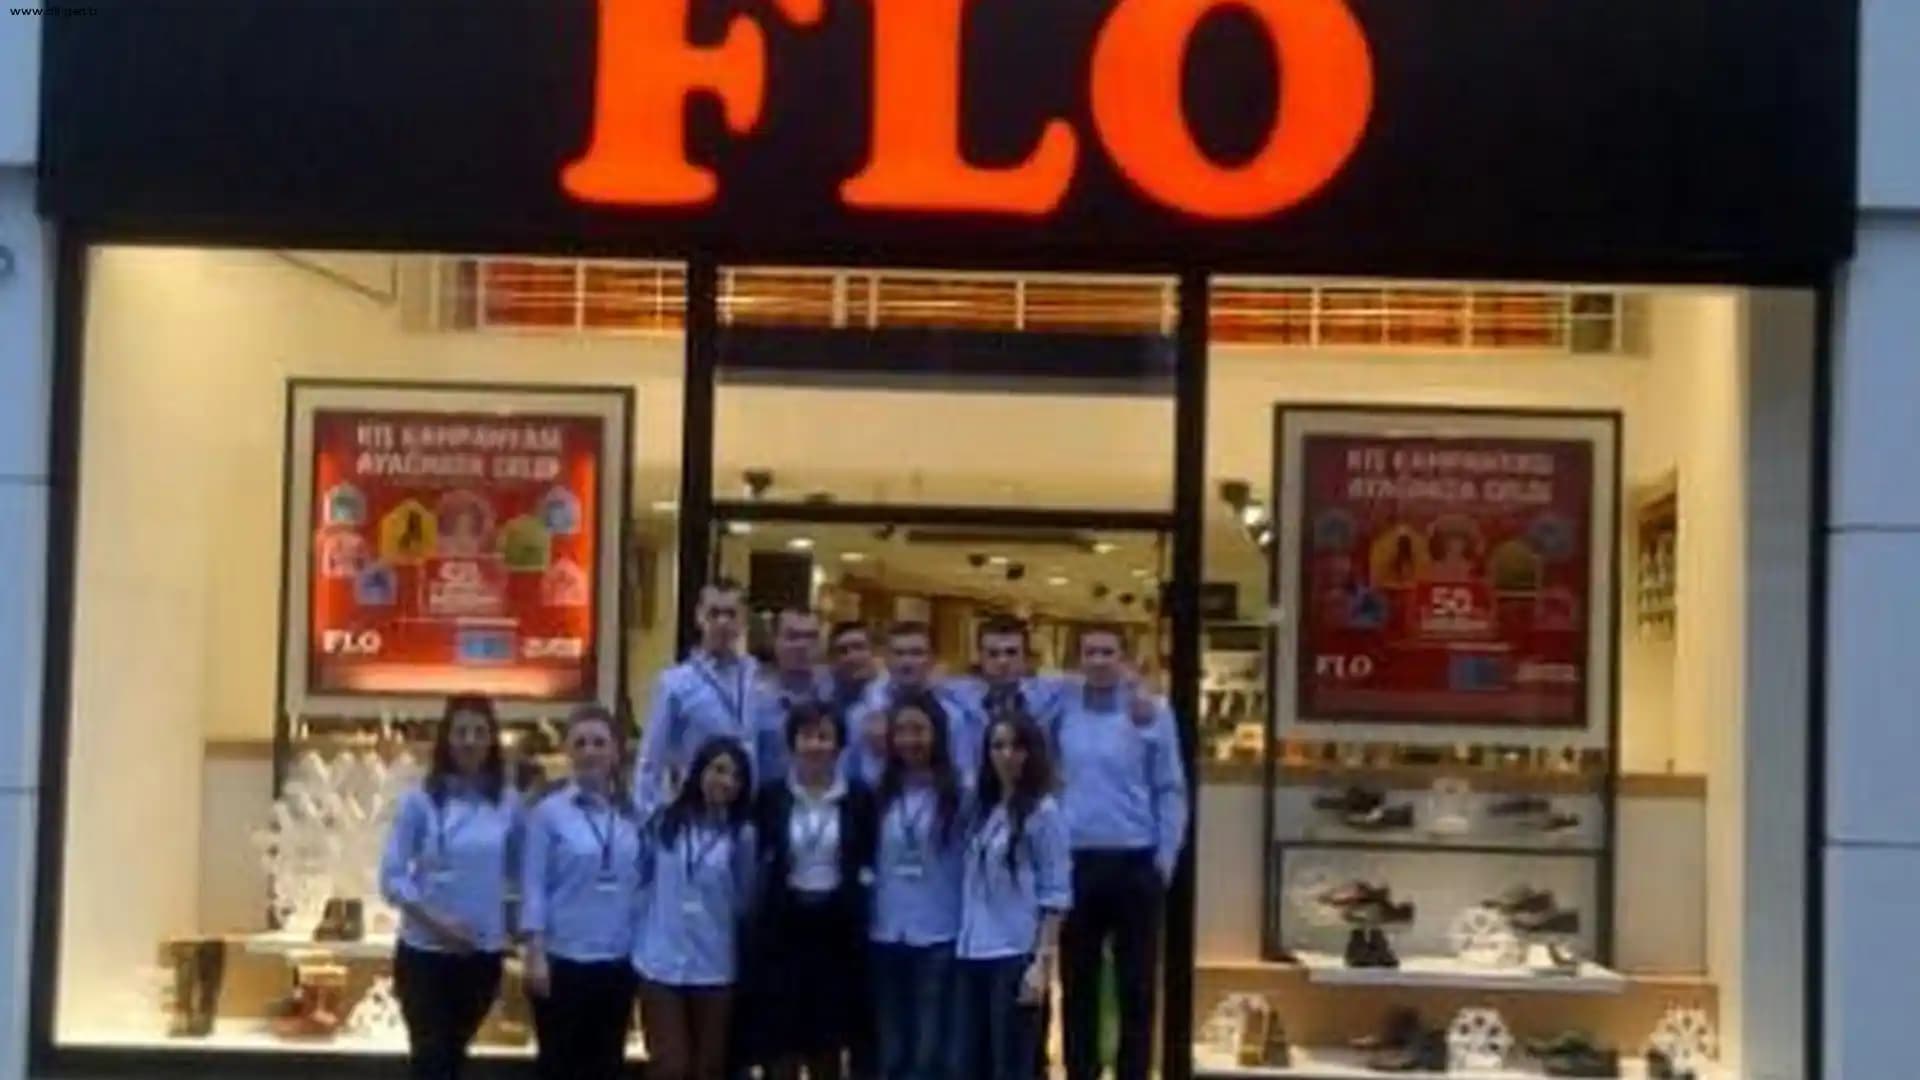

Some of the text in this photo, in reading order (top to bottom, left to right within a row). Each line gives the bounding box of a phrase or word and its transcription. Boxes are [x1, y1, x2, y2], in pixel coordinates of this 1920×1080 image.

[560, 0, 1375, 219] FLO
[322, 628, 383, 655] FLO
[1314, 653, 1373, 679] FLO
